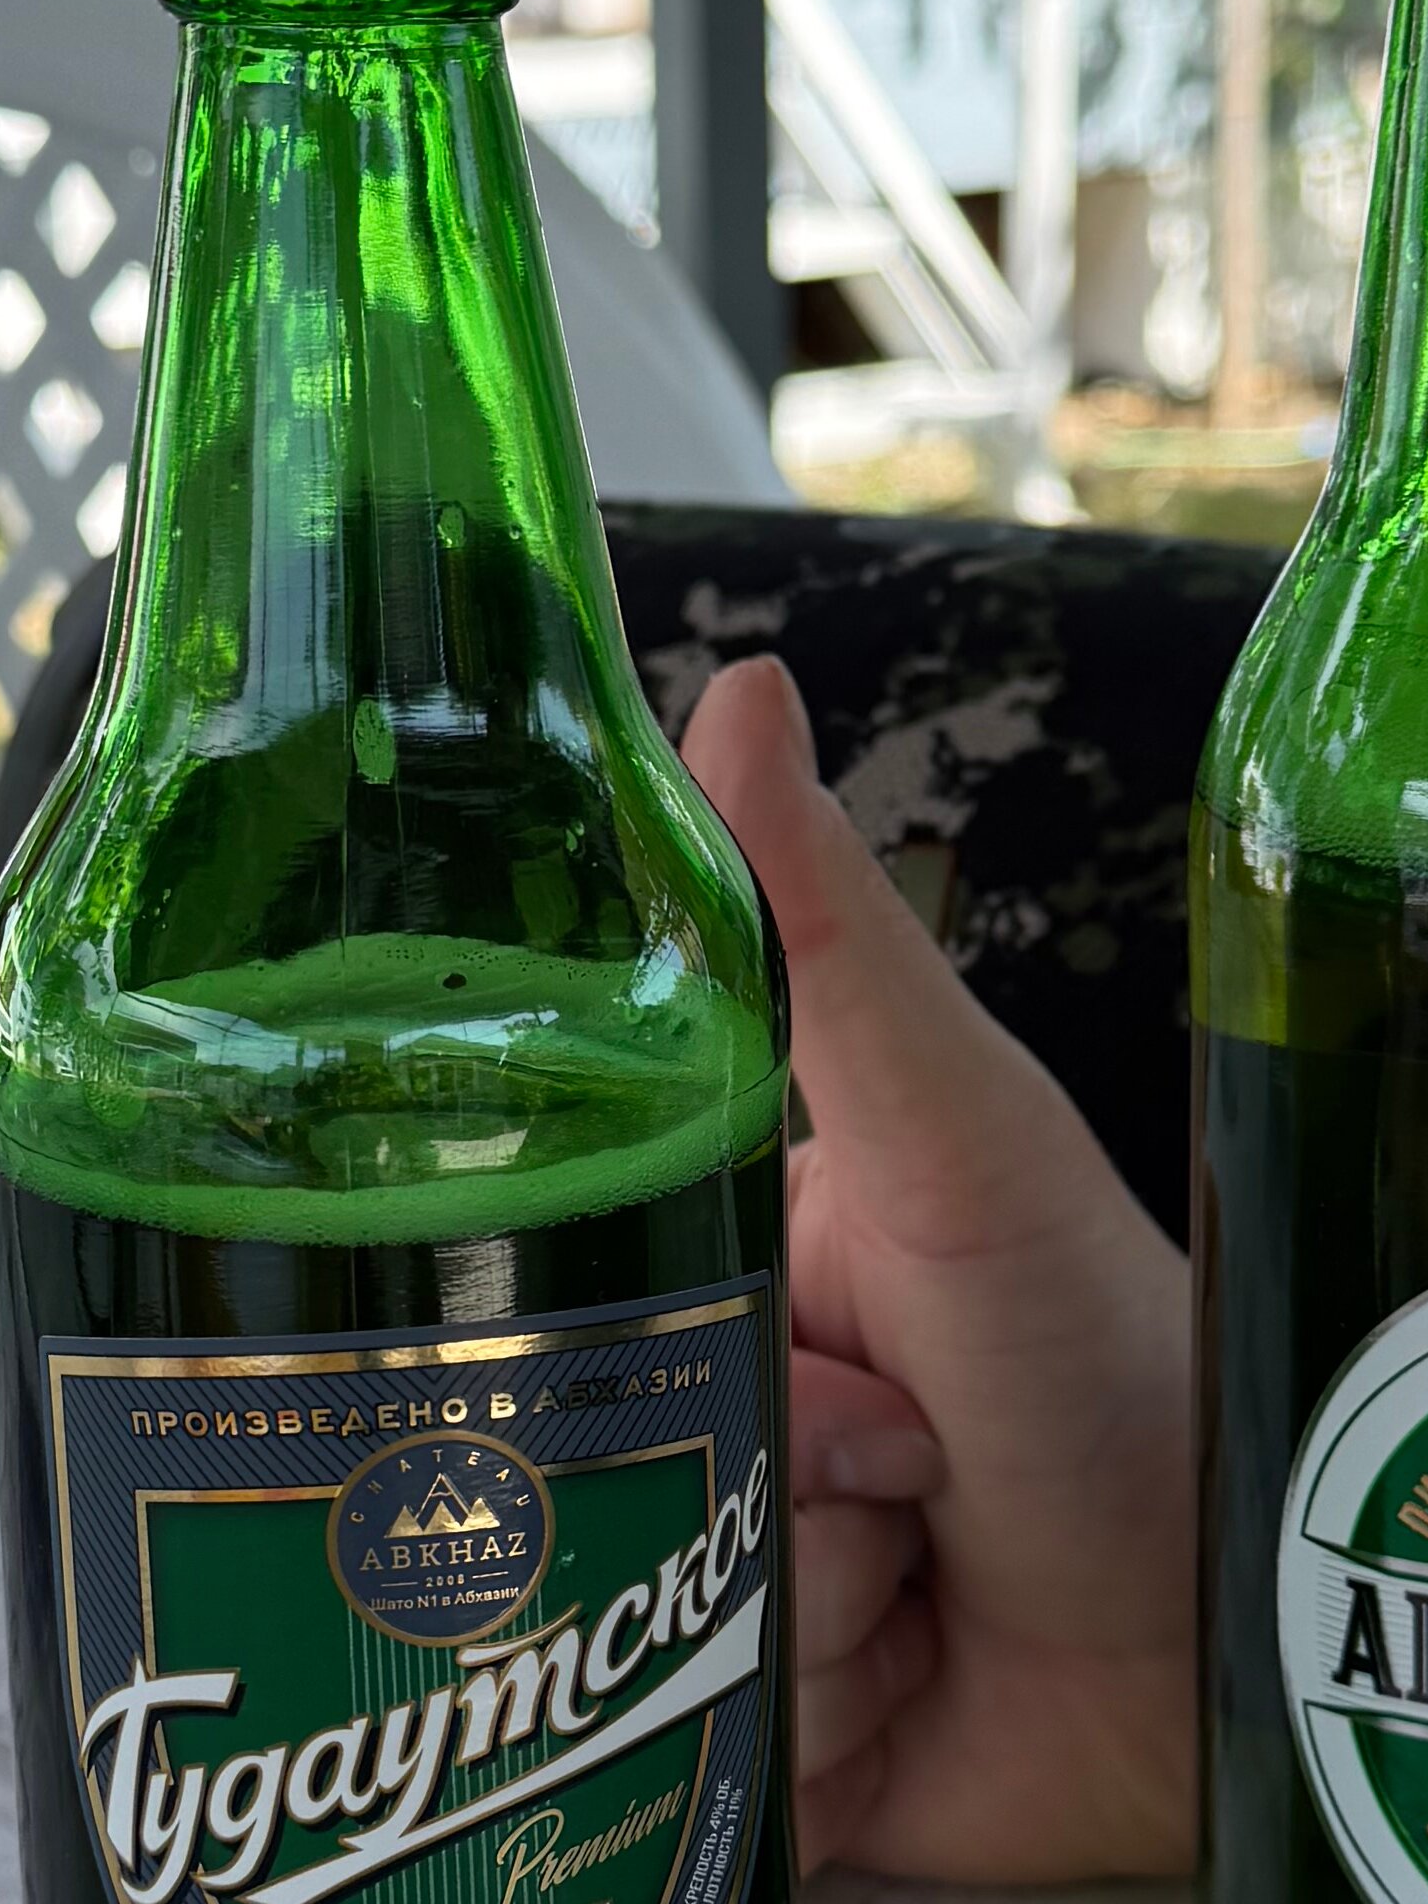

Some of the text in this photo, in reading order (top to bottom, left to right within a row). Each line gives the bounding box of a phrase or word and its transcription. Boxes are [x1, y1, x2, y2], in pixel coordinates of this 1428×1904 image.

[131, 1358, 712, 1437] ПРОИЗВЕДЕНО В АБХАЗИИ
[350, 1449, 531, 1523] CHATEAU
[359, 1532, 527, 1571] ABKHAZ
[424, 1573, 465, 1587] 2008
[709, 1802, 726, 1831] 4%
